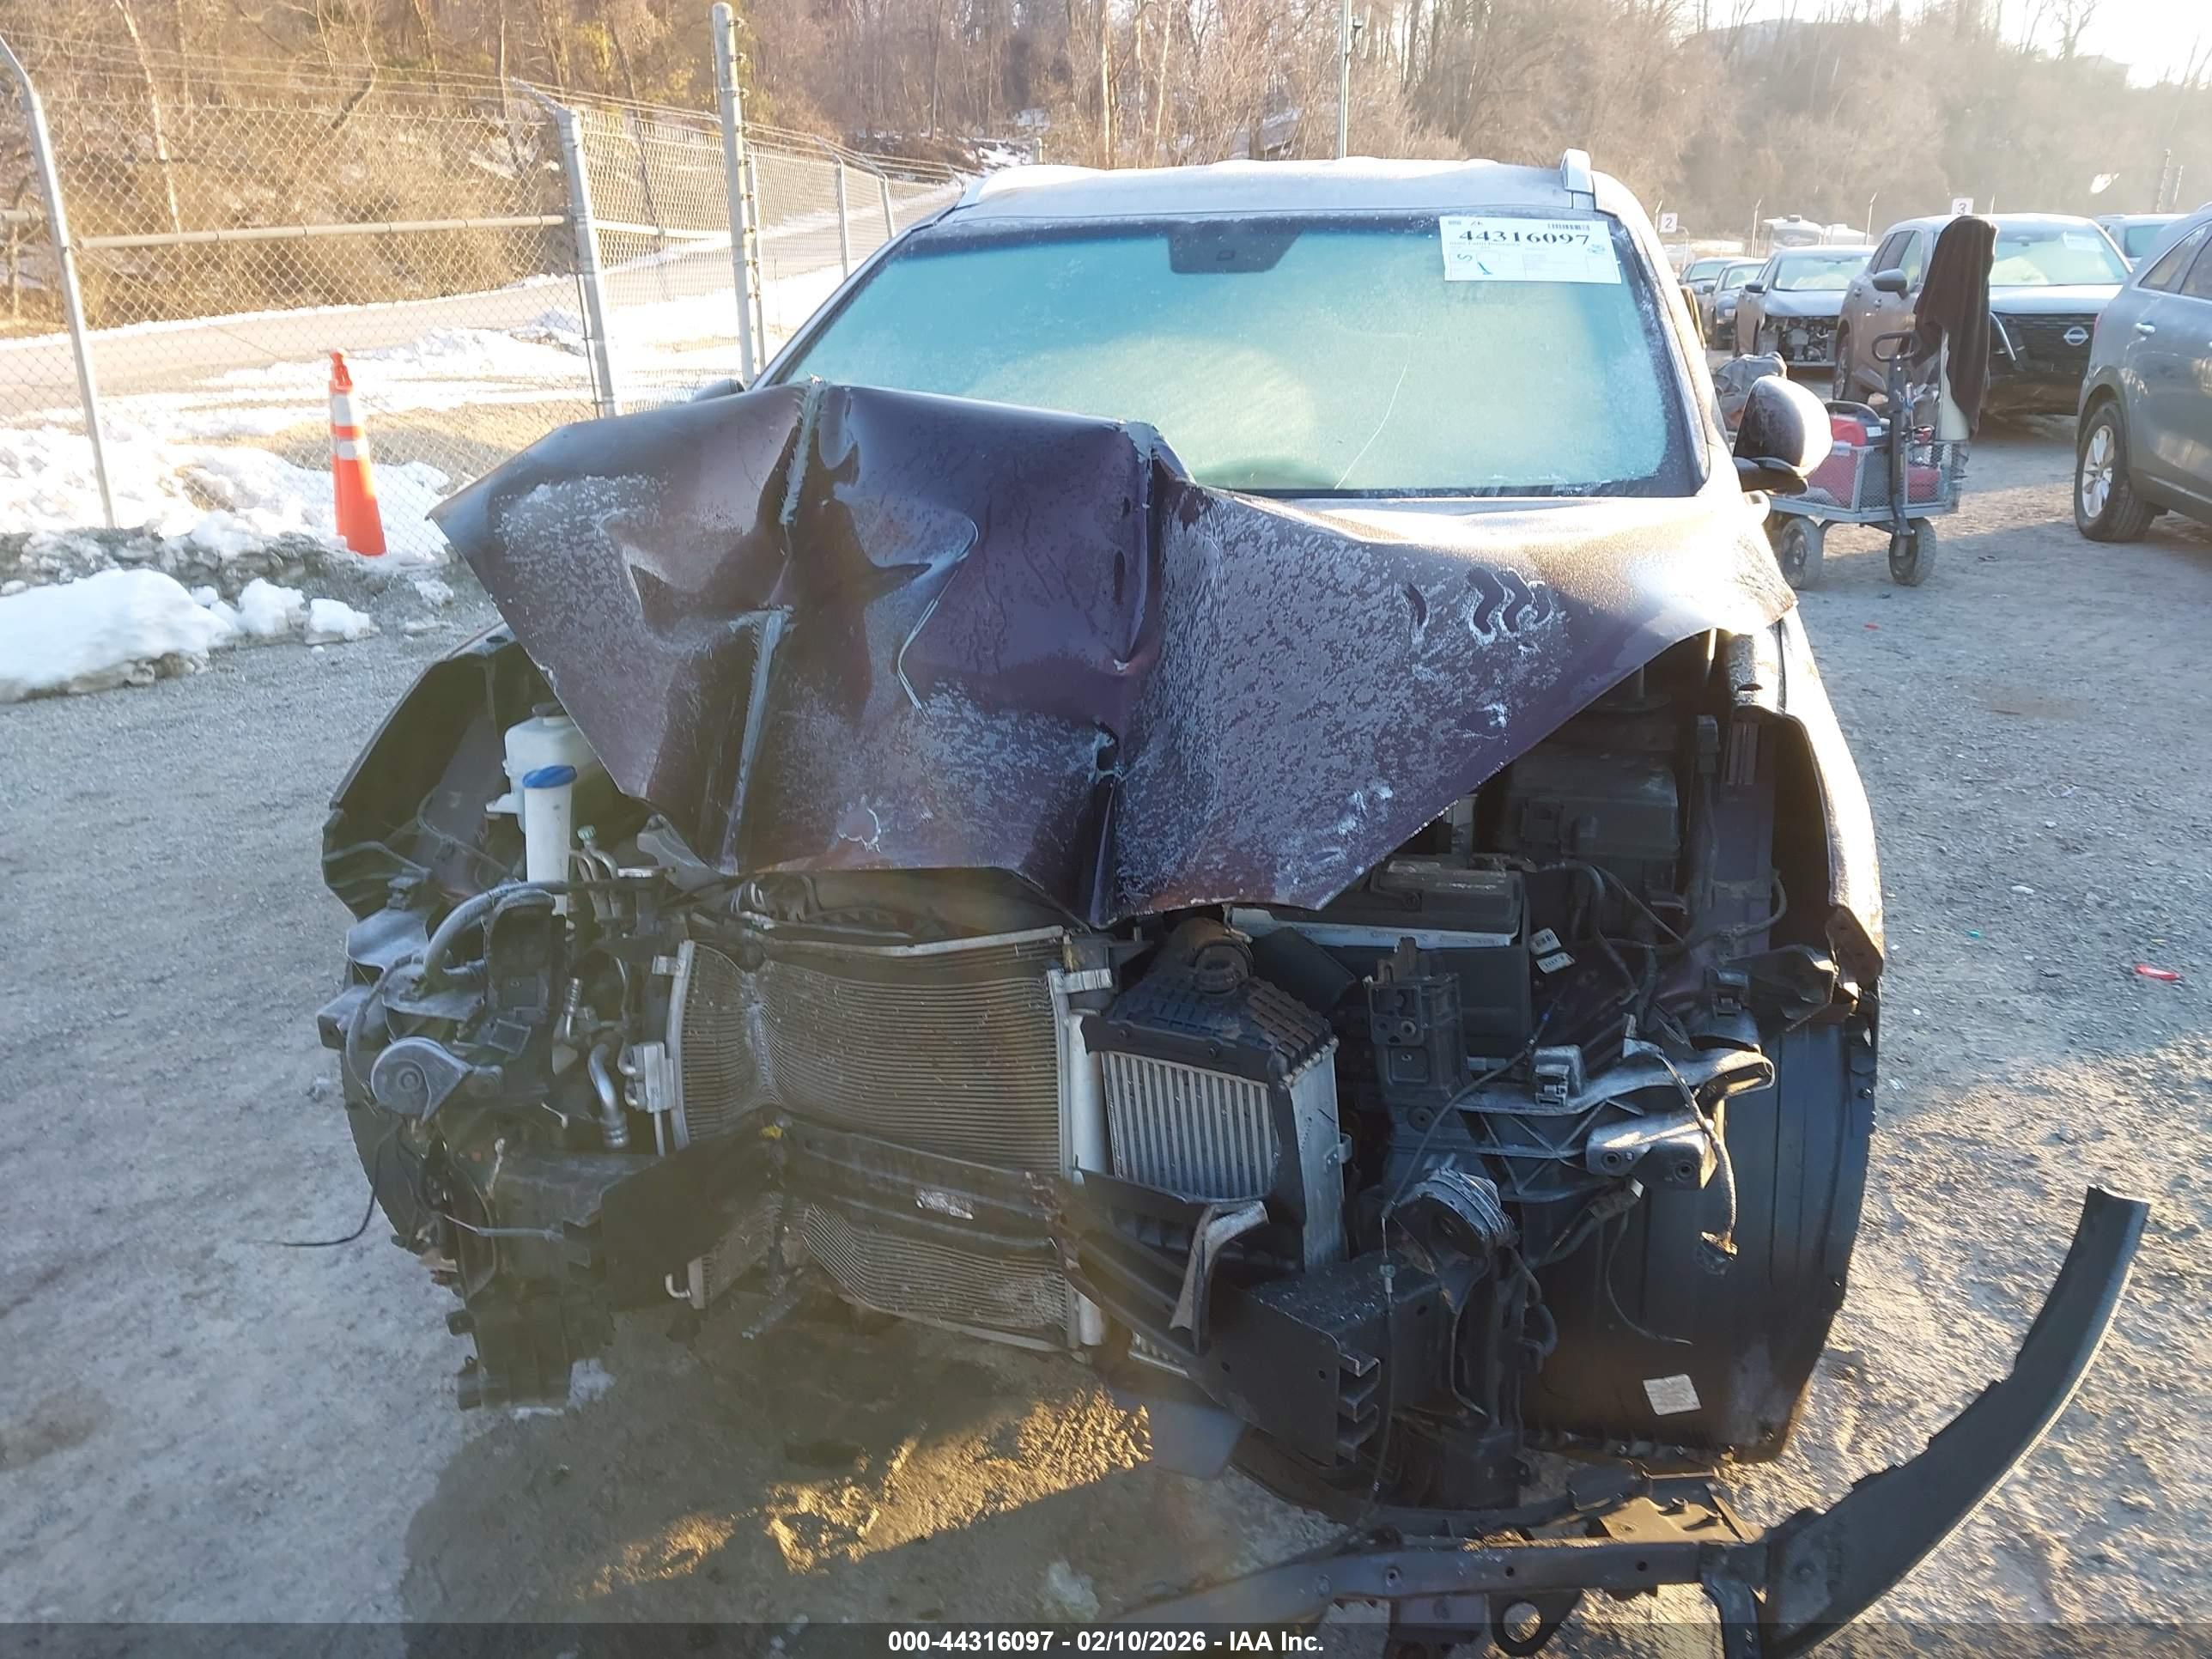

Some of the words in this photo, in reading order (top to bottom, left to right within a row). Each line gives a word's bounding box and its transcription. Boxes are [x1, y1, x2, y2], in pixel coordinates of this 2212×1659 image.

[1958, 203, 1967, 215] 3
[1665, 216, 1673, 228] 2
[1459, 230, 1589, 246] 44316097
